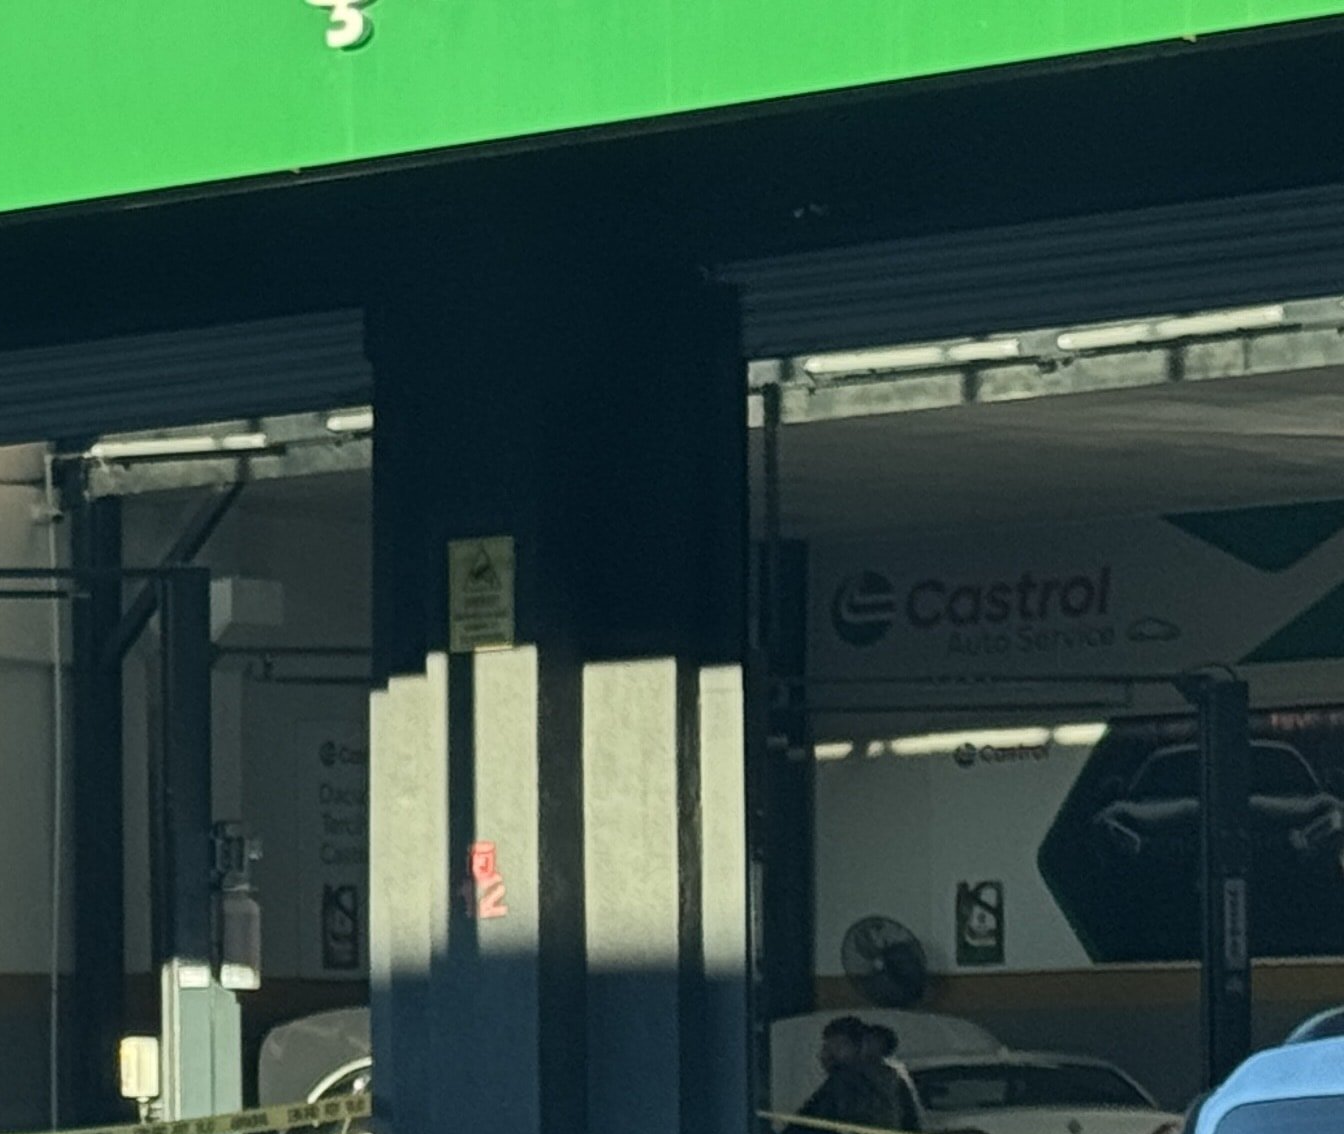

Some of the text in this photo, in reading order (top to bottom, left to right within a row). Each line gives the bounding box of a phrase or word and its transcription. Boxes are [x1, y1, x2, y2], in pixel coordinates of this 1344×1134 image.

[907, 568, 1110, 627] Castrol
[946, 625, 1115, 656] Auto Service
